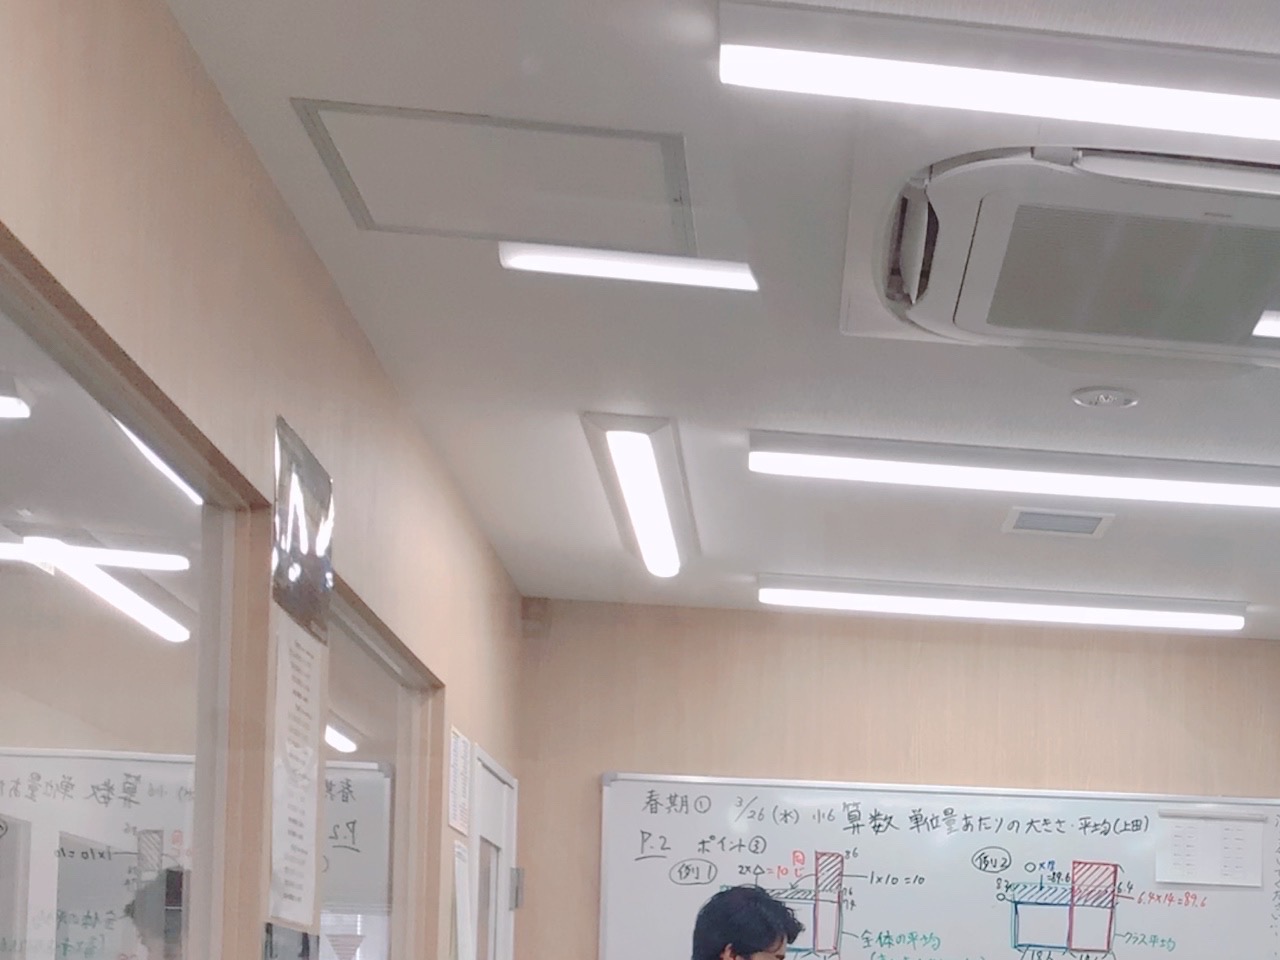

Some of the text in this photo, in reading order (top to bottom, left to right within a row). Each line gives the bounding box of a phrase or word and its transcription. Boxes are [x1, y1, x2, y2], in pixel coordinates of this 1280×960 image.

[641, 789, 711, 814] 春期①
[640, 830, 671, 854] P.2
[861, 929, 941, 951] 全体の平均
[1124, 932, 1176, 951] クラス平均
